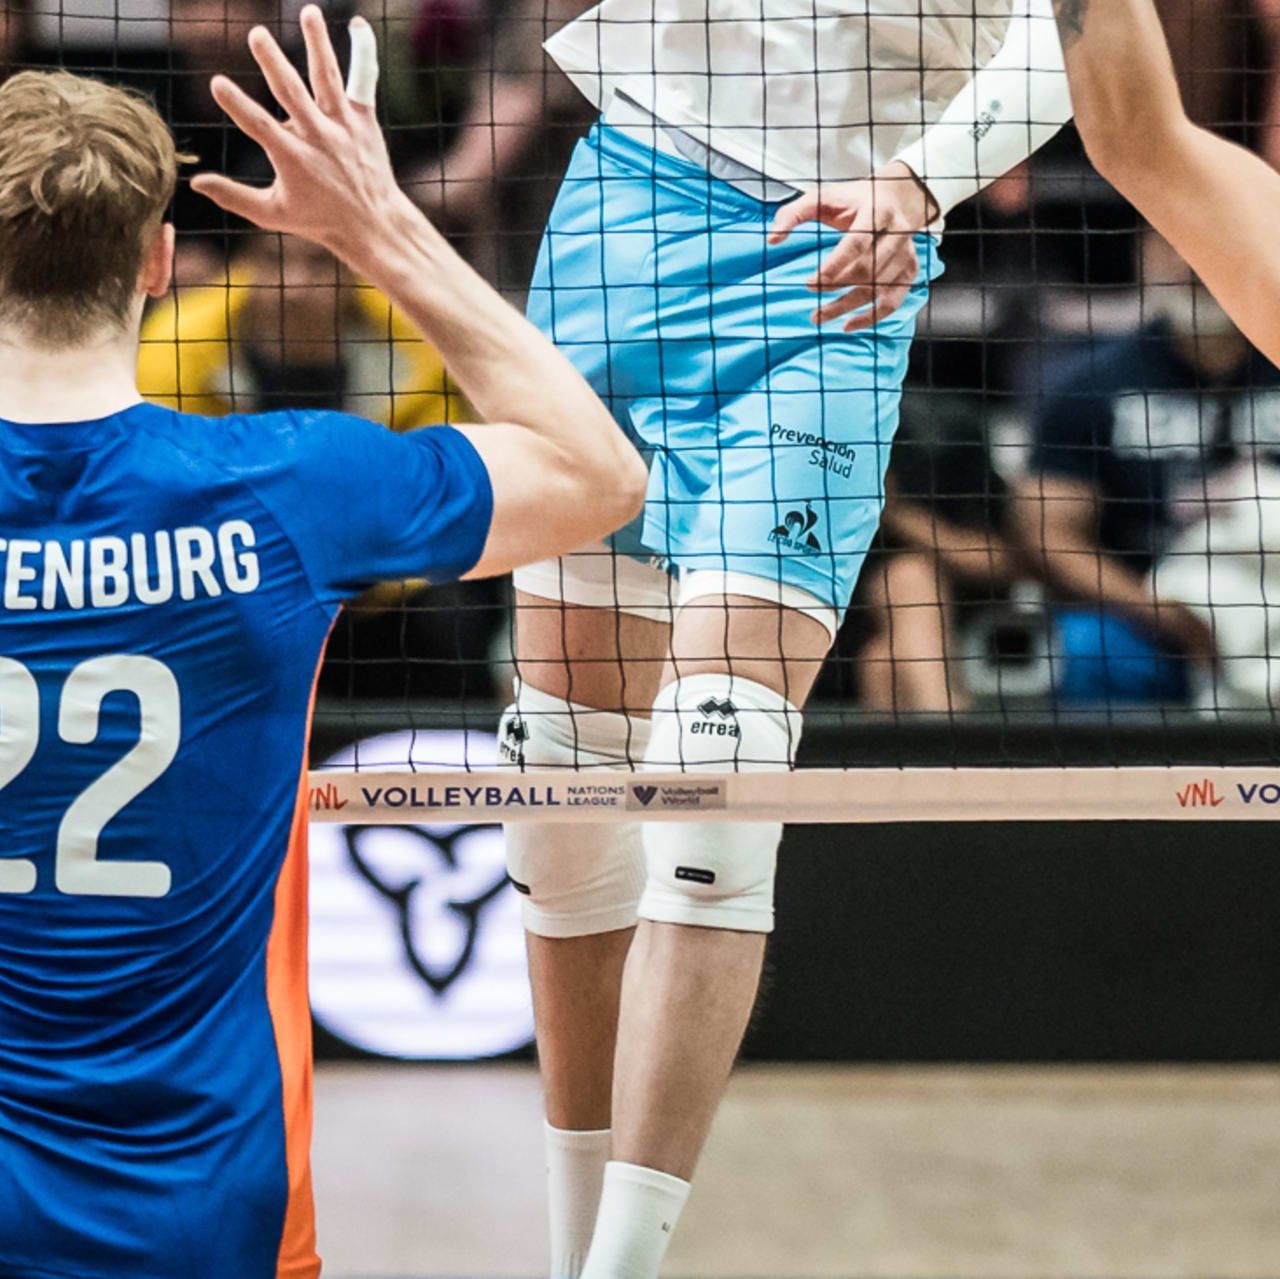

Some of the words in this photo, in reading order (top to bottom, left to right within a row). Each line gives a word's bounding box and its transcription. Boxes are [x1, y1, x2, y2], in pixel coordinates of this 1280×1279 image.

[808, 448, 854, 480] Salud
[360, 786, 561, 807] VOLLEYBALL
[567, 785, 625, 796] NATIONS
[567, 797, 618, 807] LEAGUE
[1175, 778, 1225, 808] VNL
